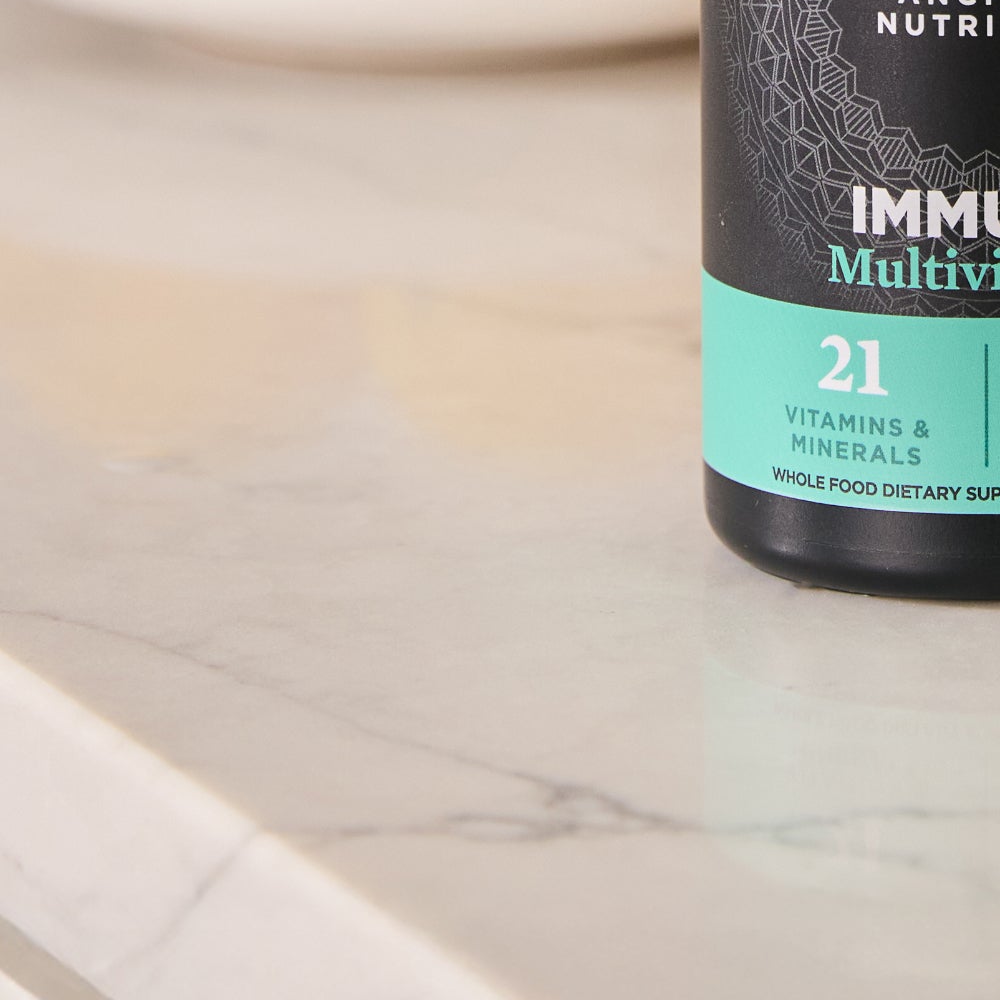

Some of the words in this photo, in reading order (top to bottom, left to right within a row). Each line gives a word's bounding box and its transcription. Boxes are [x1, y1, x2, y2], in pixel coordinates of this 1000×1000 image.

[817, 334, 889, 396] 21
[785, 404, 903, 437] VITAMINS
[912, 420, 930, 439] &
[791, 434, 922, 466] MINERALS
[772, 466, 825, 490] WHOLE
[829, 476, 879, 496] FOOD
[882, 482, 962, 500] DIETARY
